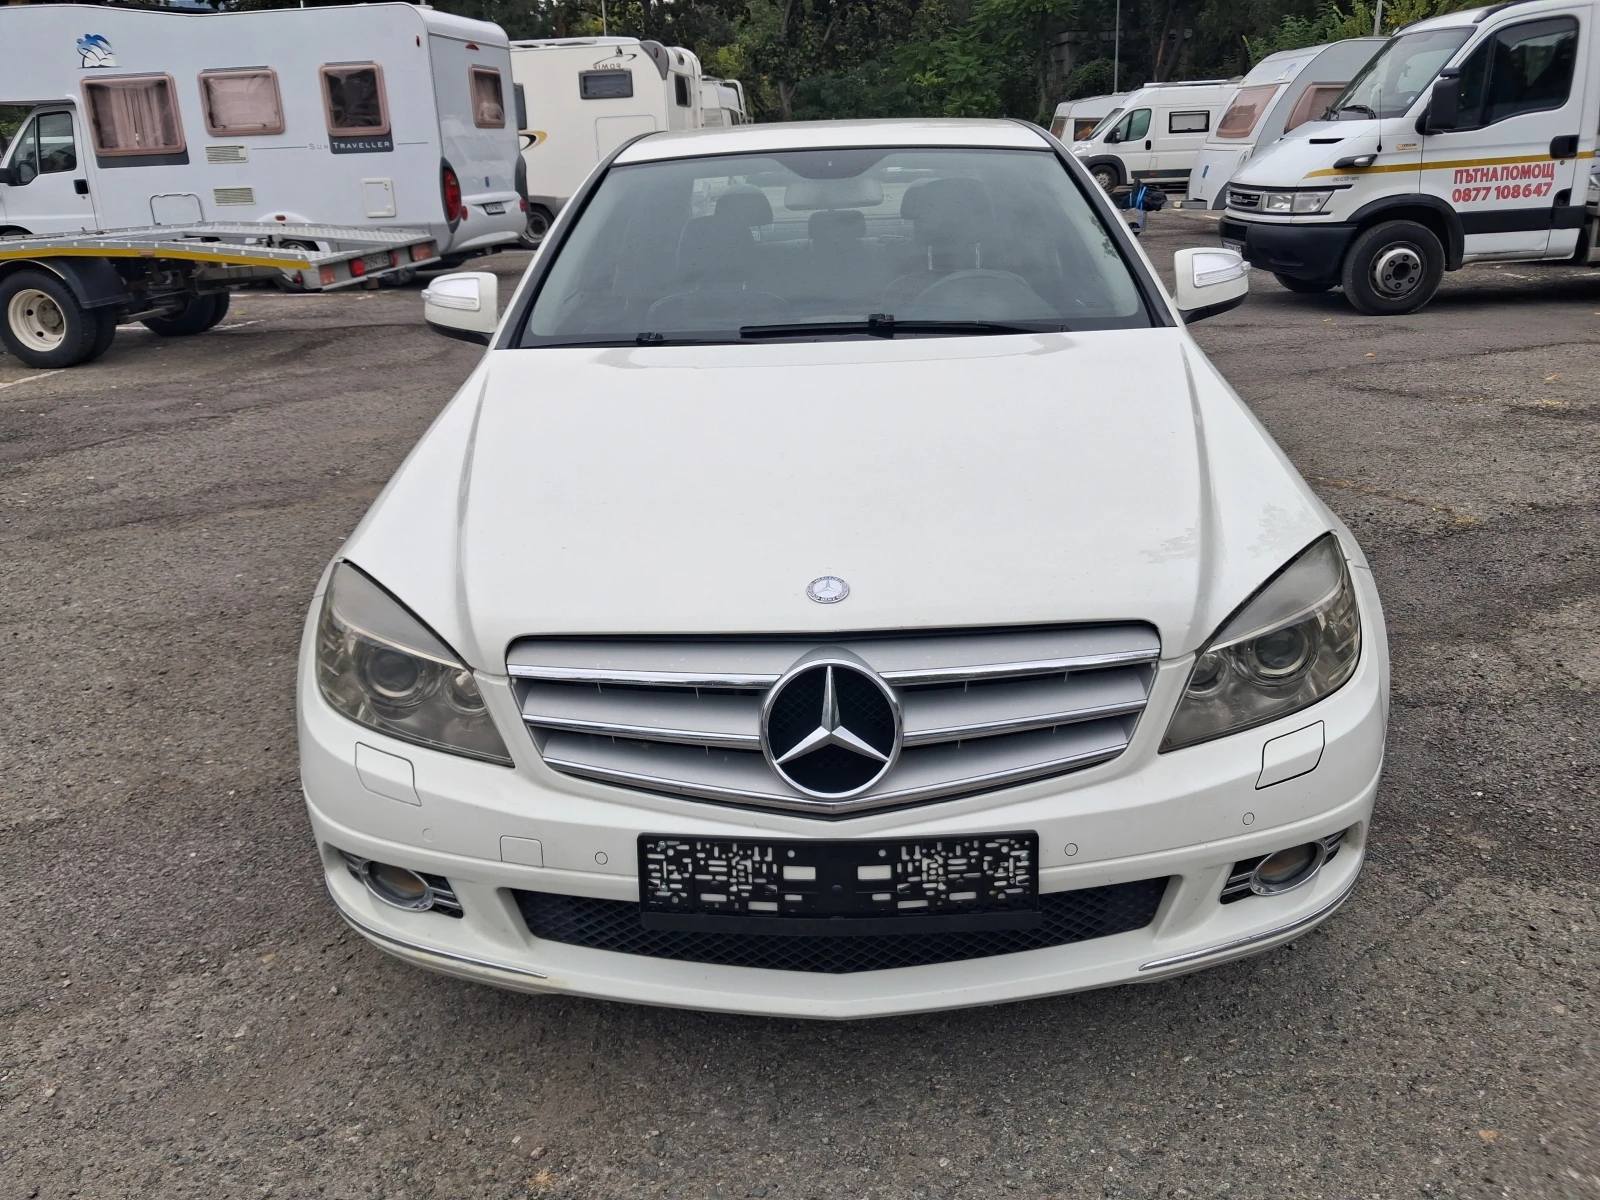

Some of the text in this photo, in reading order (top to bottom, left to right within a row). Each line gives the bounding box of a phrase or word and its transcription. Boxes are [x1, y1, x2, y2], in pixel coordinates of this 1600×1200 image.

[333, 141, 390, 149] TRAVELLER
[1452, 182, 1553, 202] 0877 108647
